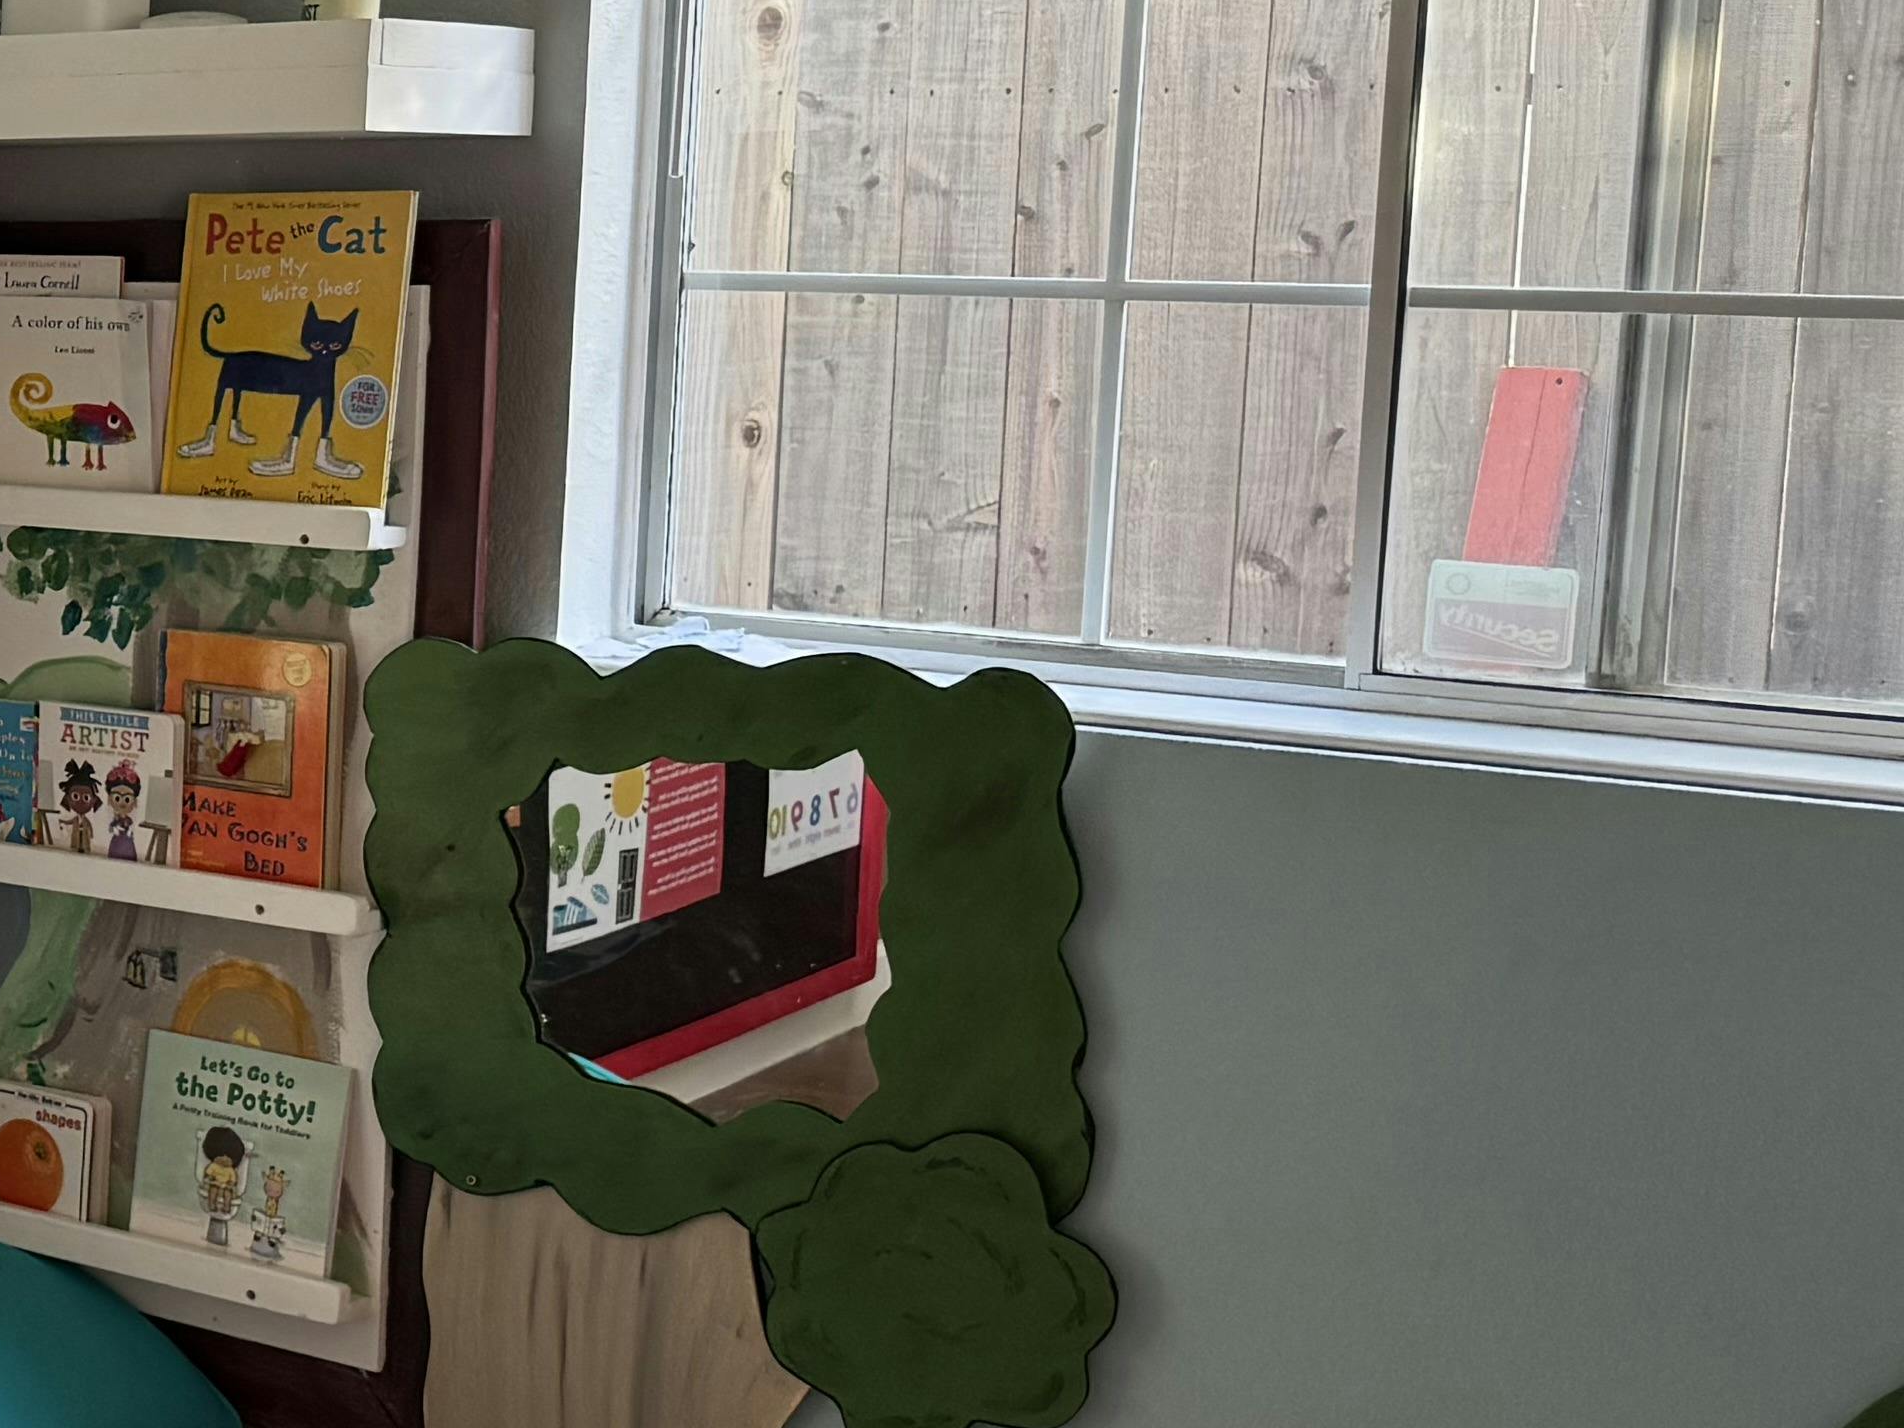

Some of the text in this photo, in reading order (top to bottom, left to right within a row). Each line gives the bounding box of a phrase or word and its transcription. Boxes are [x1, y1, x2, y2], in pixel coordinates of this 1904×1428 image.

[205, 213, 387, 256] Pete the Cat
[236, 264, 272, 281] Love
[280, 258, 308, 277] My
[261, 278, 362, 302] White Shoes
[12, 316, 130, 332] A color of his own
[350, 391, 379, 405] FREE
[60, 724, 149, 753] ARTIST
[228, 821, 308, 852] GOGH'S
[244, 851, 285, 877] BED
[200, 1056, 294, 1089] Let's Go to
[176, 1072, 316, 1126] the Potty!
[36, 1109, 81, 1131] shapes
[204, 1109, 236, 1124] Training
